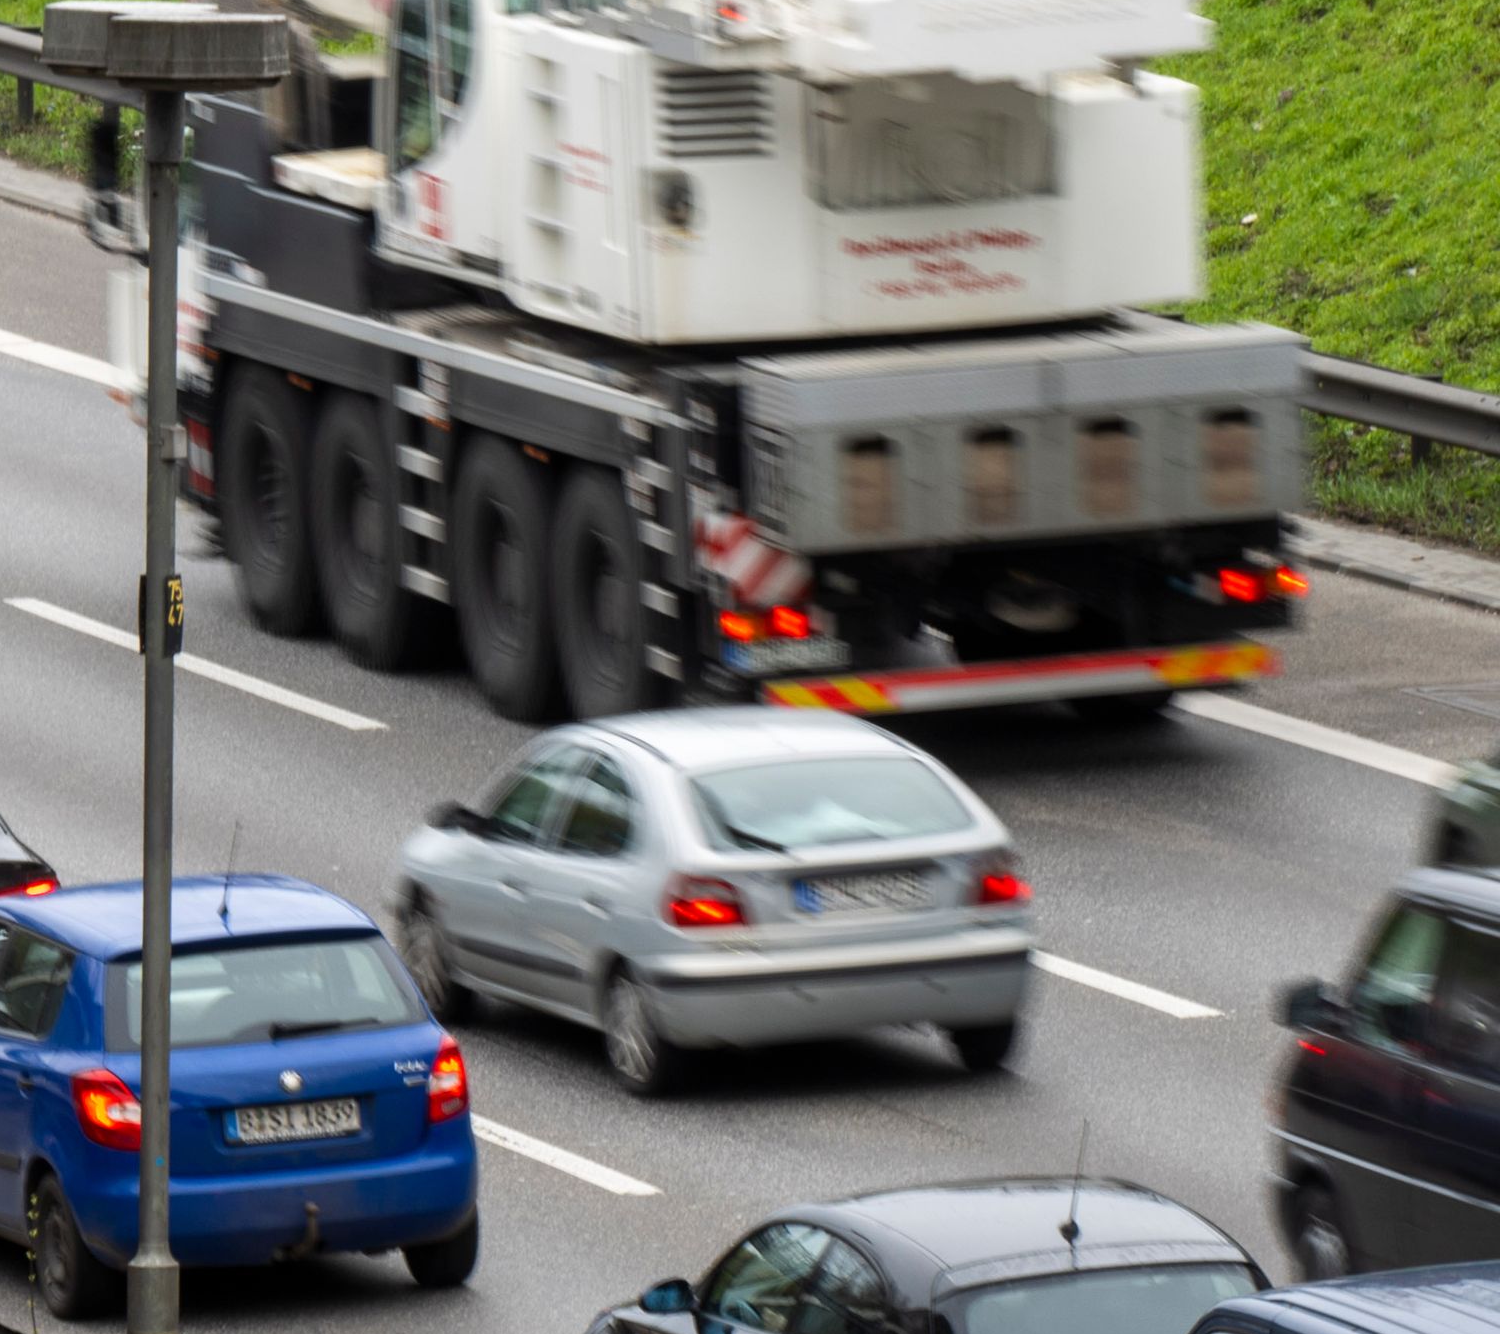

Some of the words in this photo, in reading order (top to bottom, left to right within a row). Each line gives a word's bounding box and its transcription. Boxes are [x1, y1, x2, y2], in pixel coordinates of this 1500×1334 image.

[167, 578, 183, 602] 75
[167, 603, 184, 627] 47
[239, 1114, 255, 1134] B
[268, 1108, 293, 1130] SI
